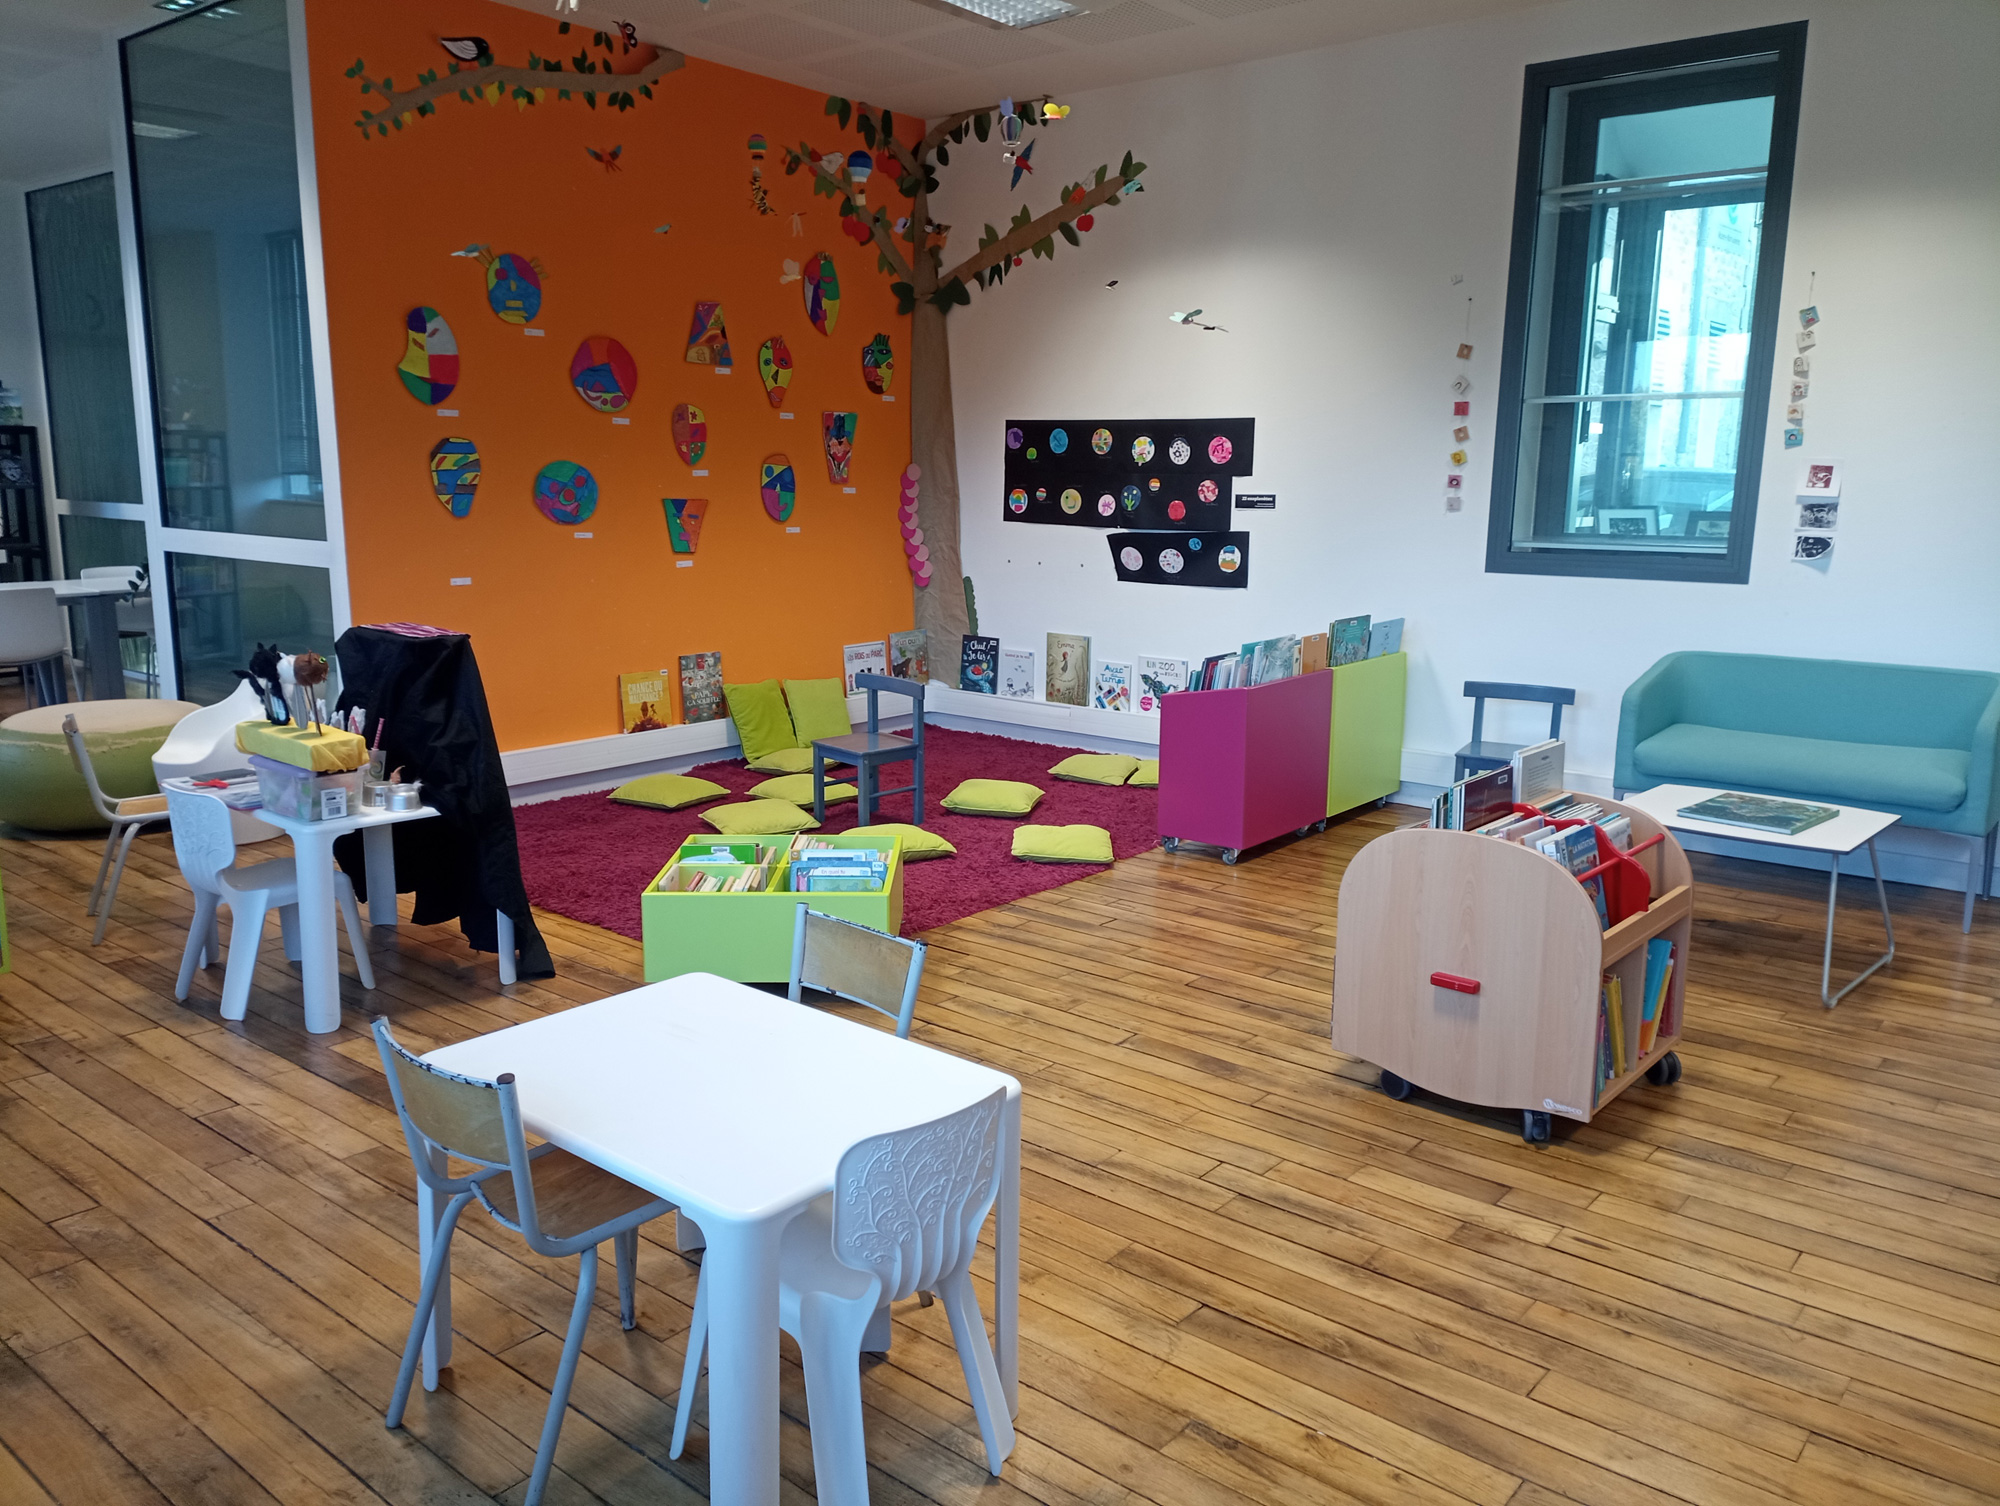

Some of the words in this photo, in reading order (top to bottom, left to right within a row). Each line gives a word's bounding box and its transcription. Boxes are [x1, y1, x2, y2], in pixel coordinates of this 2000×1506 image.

[970, 640, 986, 650] Chut
[1057, 640, 1075, 649] Emma
[854, 651, 865, 660] ROIS
[870, 648, 883, 658] PARC
[968, 651, 976, 660] Je
[977, 652, 985, 661] lis
[1103, 664, 1124, 674] Avec
[1158, 661, 1175, 671] ZOO
[1100, 673, 1125, 688] Temps
[628, 682, 652, 693] CHANCE
